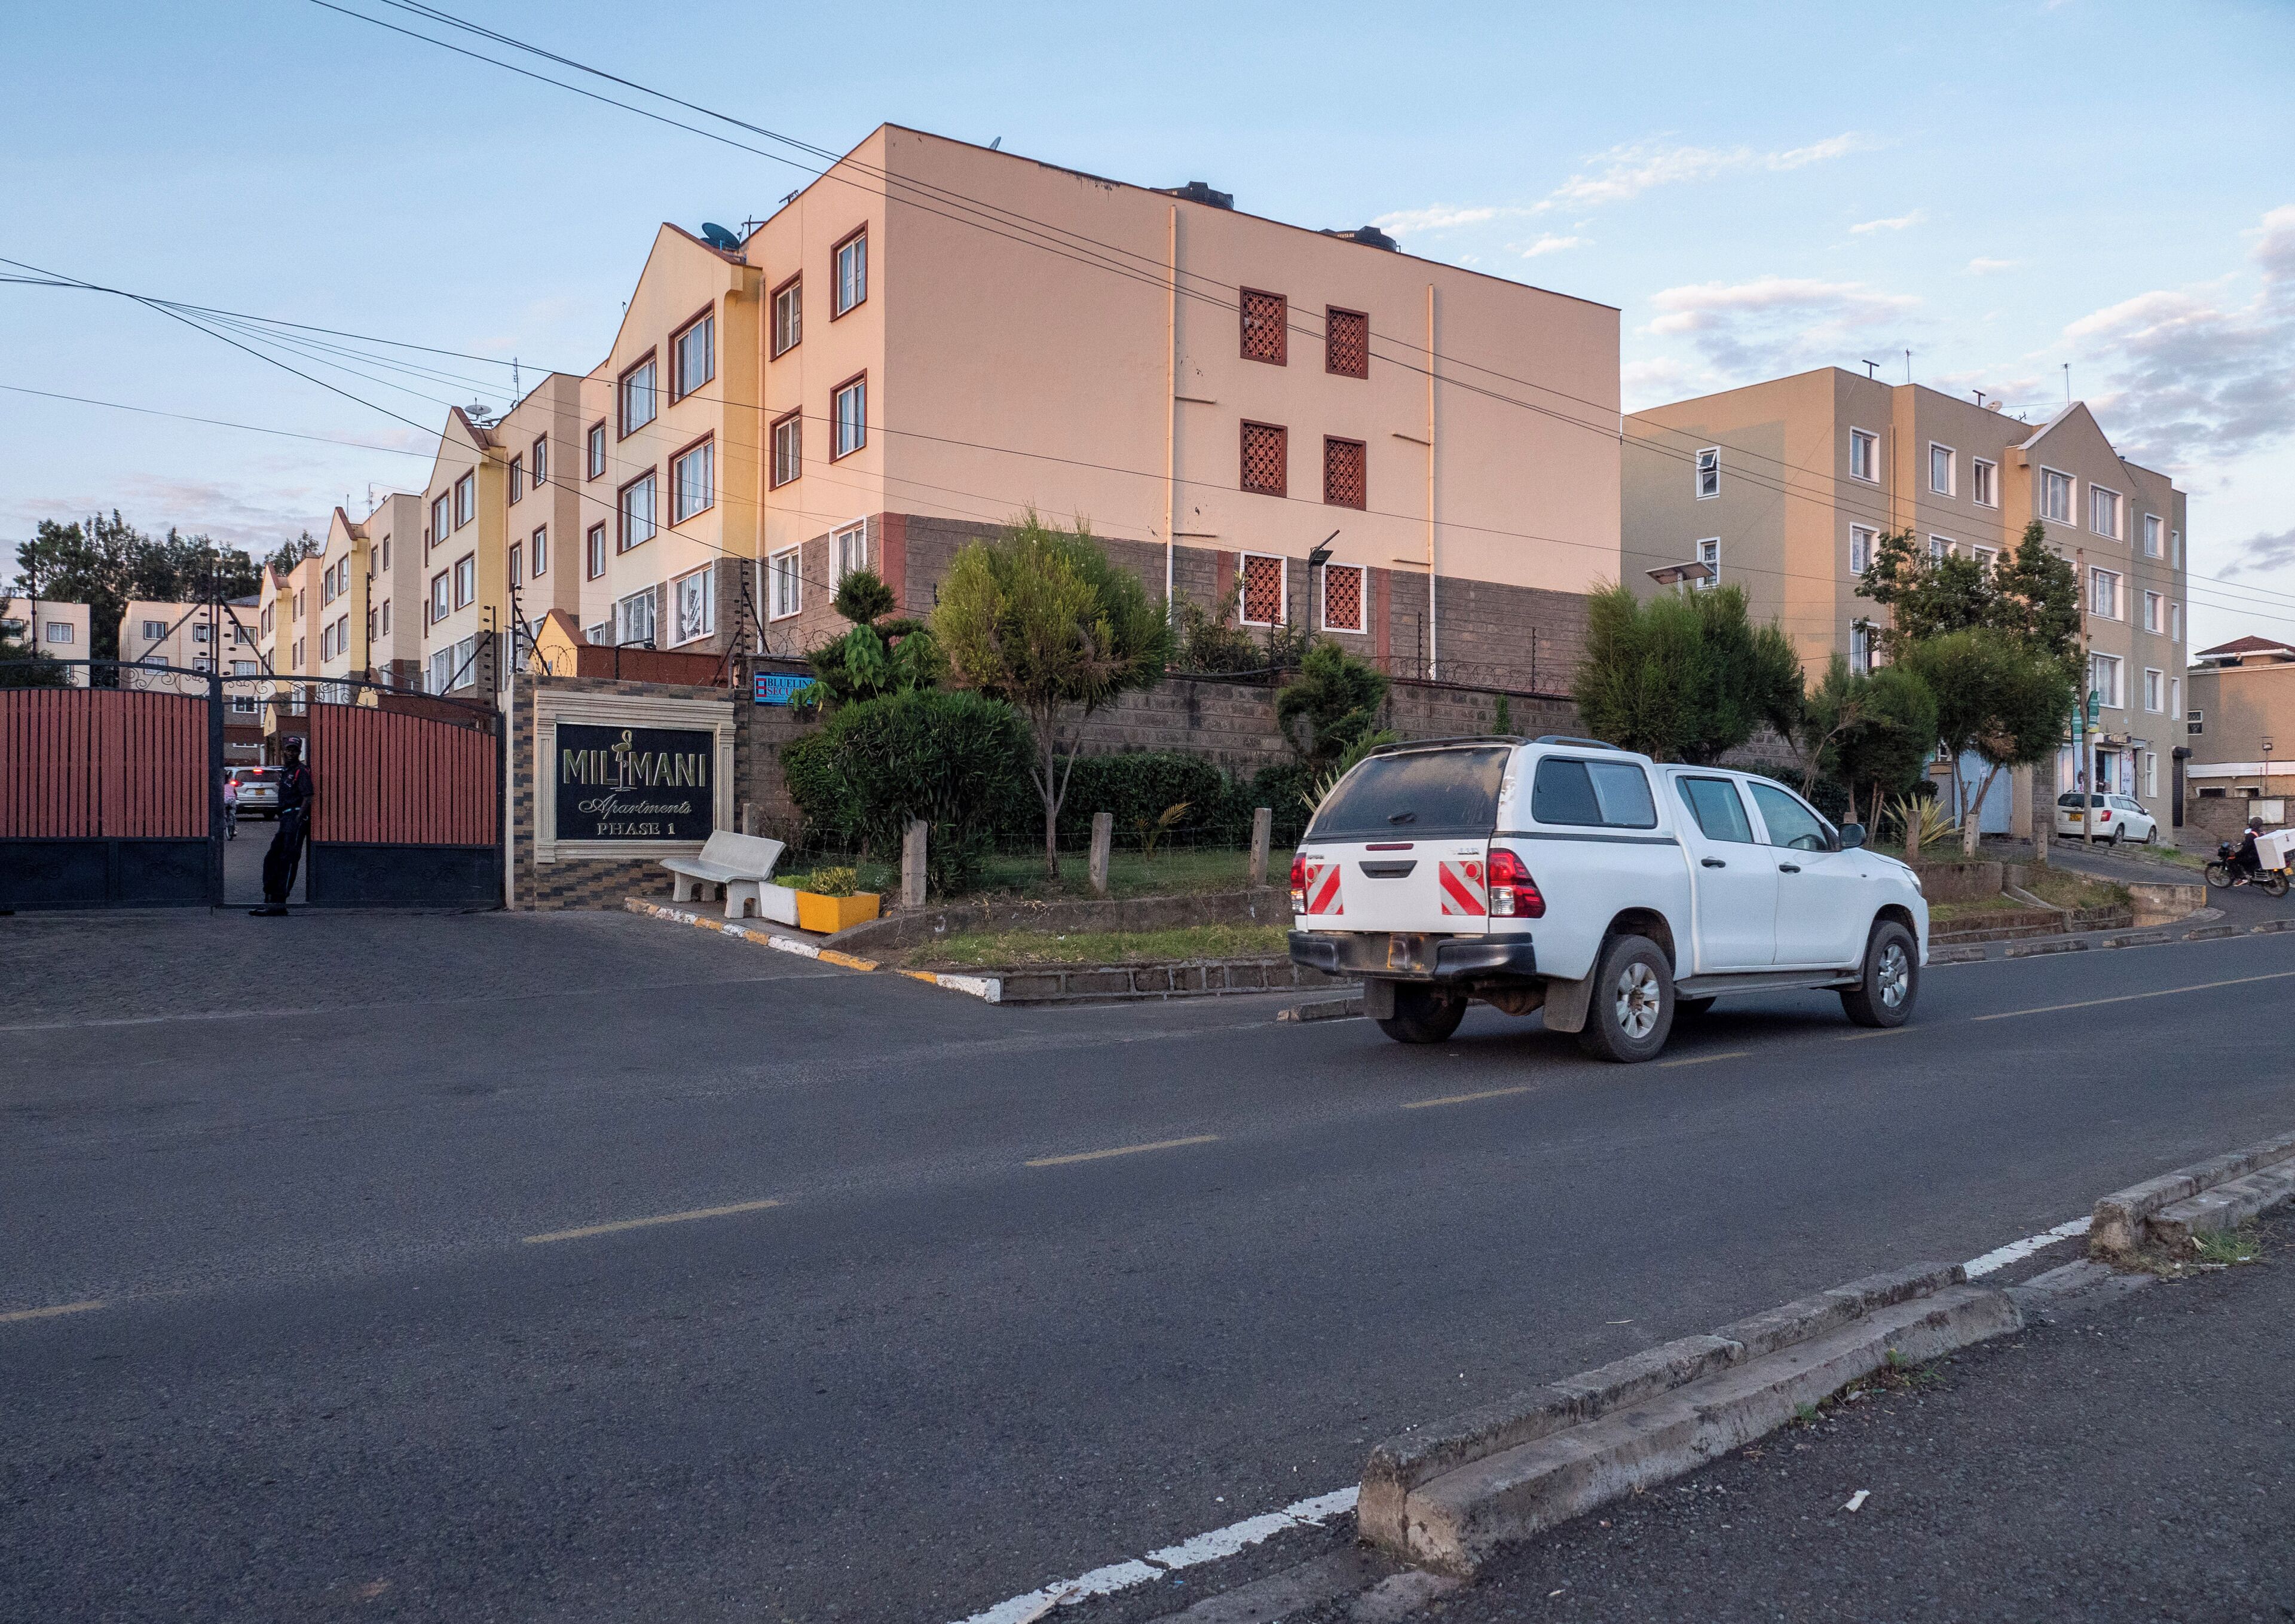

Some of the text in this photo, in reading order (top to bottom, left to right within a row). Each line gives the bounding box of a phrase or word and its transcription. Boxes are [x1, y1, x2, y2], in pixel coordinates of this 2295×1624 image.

[579, 794, 692, 820] Apartments
[597, 822, 676, 836] PHASE 1
